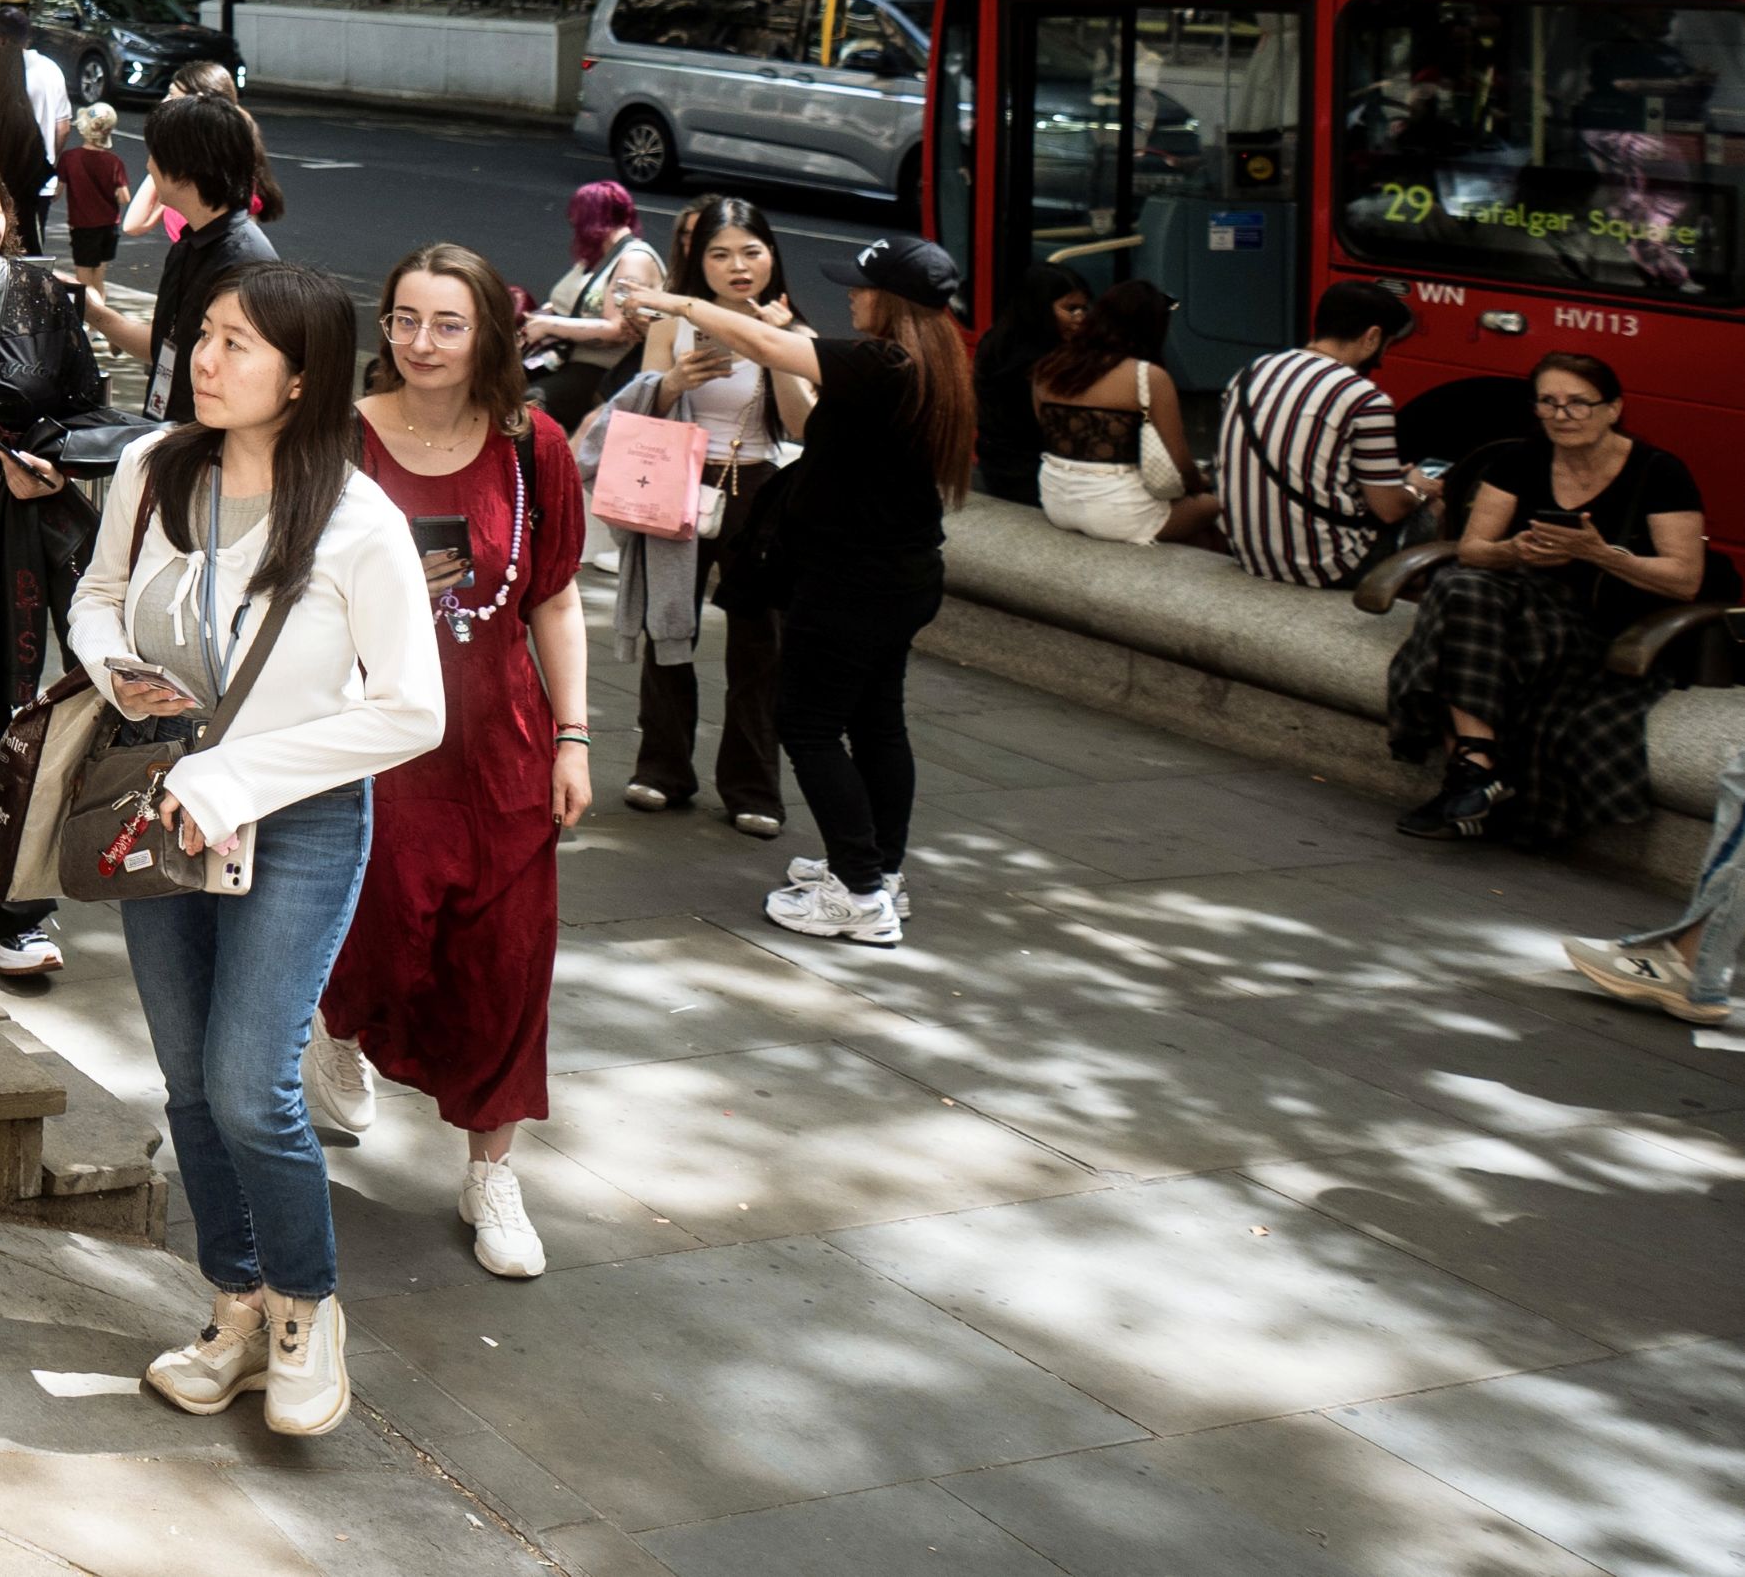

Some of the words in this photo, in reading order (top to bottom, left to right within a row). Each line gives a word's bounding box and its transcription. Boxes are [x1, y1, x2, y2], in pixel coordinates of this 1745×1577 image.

[1381, 182, 1434, 223] 29
[1459, 200, 1574, 237] rafalgar
[1587, 208, 1698, 246] Square
[1416, 281, 1466, 306] WN
[1554, 307, 1640, 337] HV113
